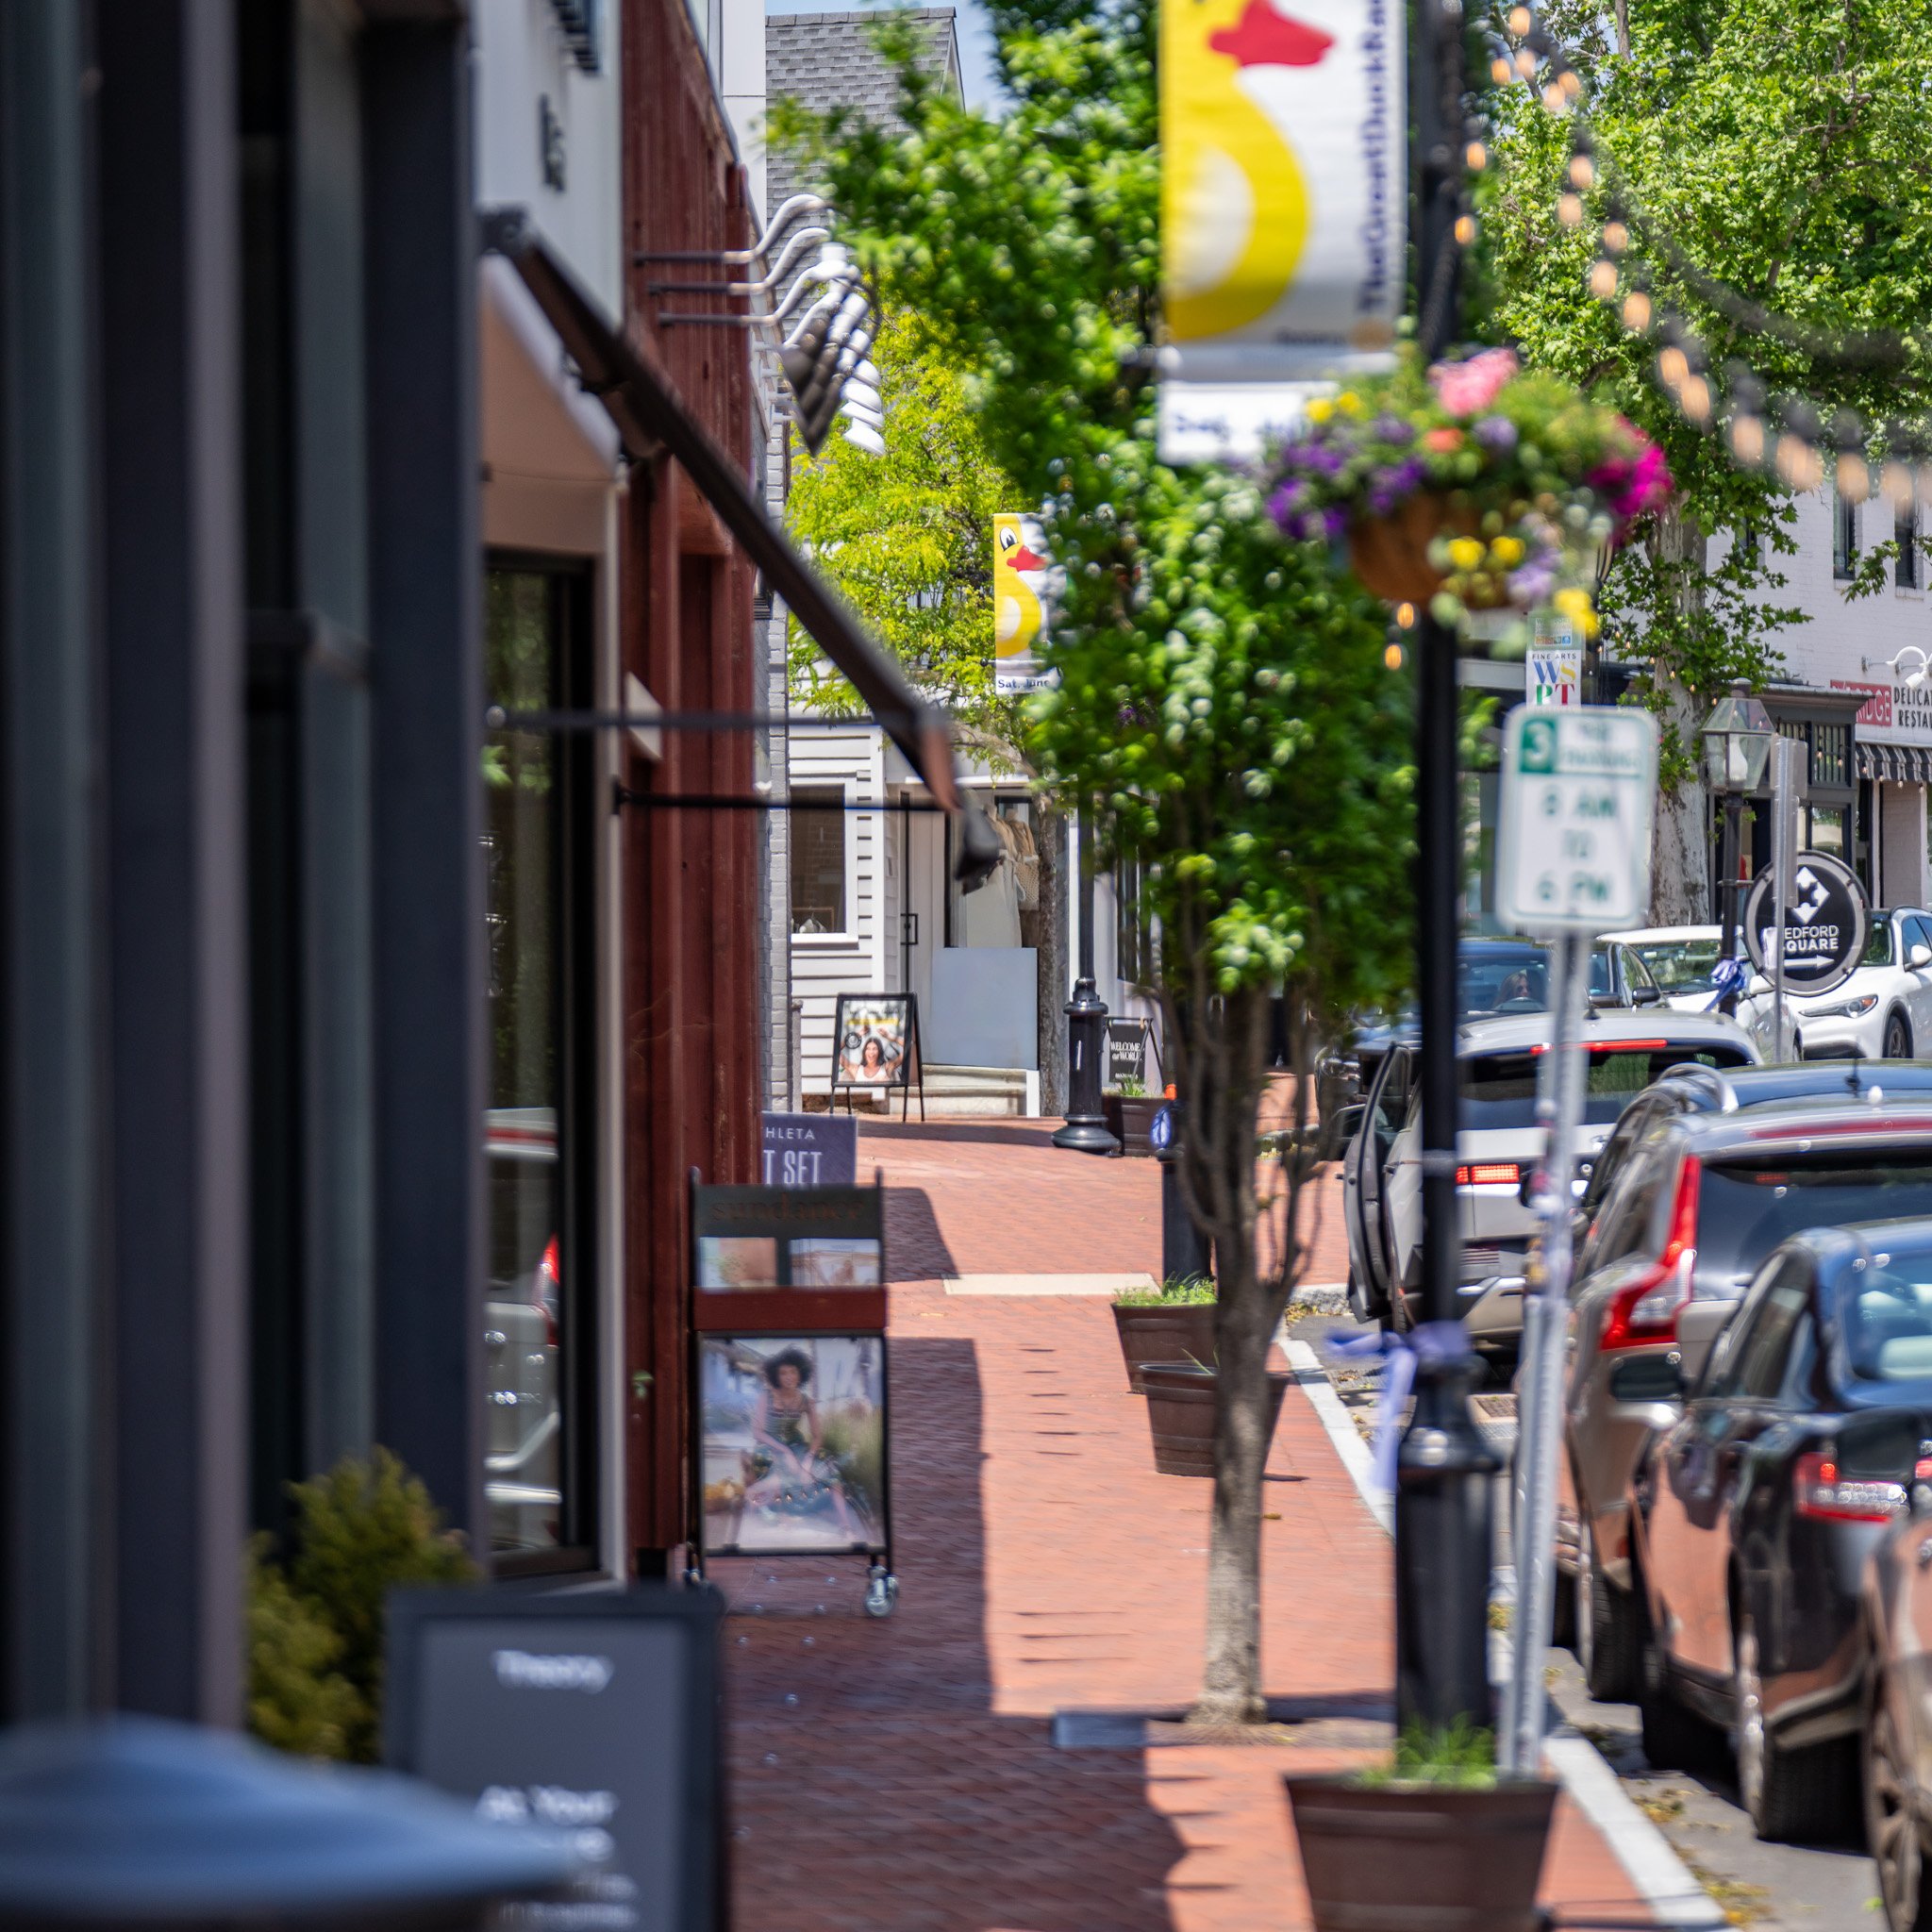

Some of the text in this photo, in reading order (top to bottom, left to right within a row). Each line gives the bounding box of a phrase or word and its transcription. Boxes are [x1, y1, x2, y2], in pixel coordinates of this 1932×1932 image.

[1522, 722, 1550, 770] 3
[1784, 925, 1840, 940] EDFORD
[1783, 938, 1840, 952] QUARE
[1110, 1041, 1141, 1051] WELCOME
[762, 1127, 815, 1140] HLETA
